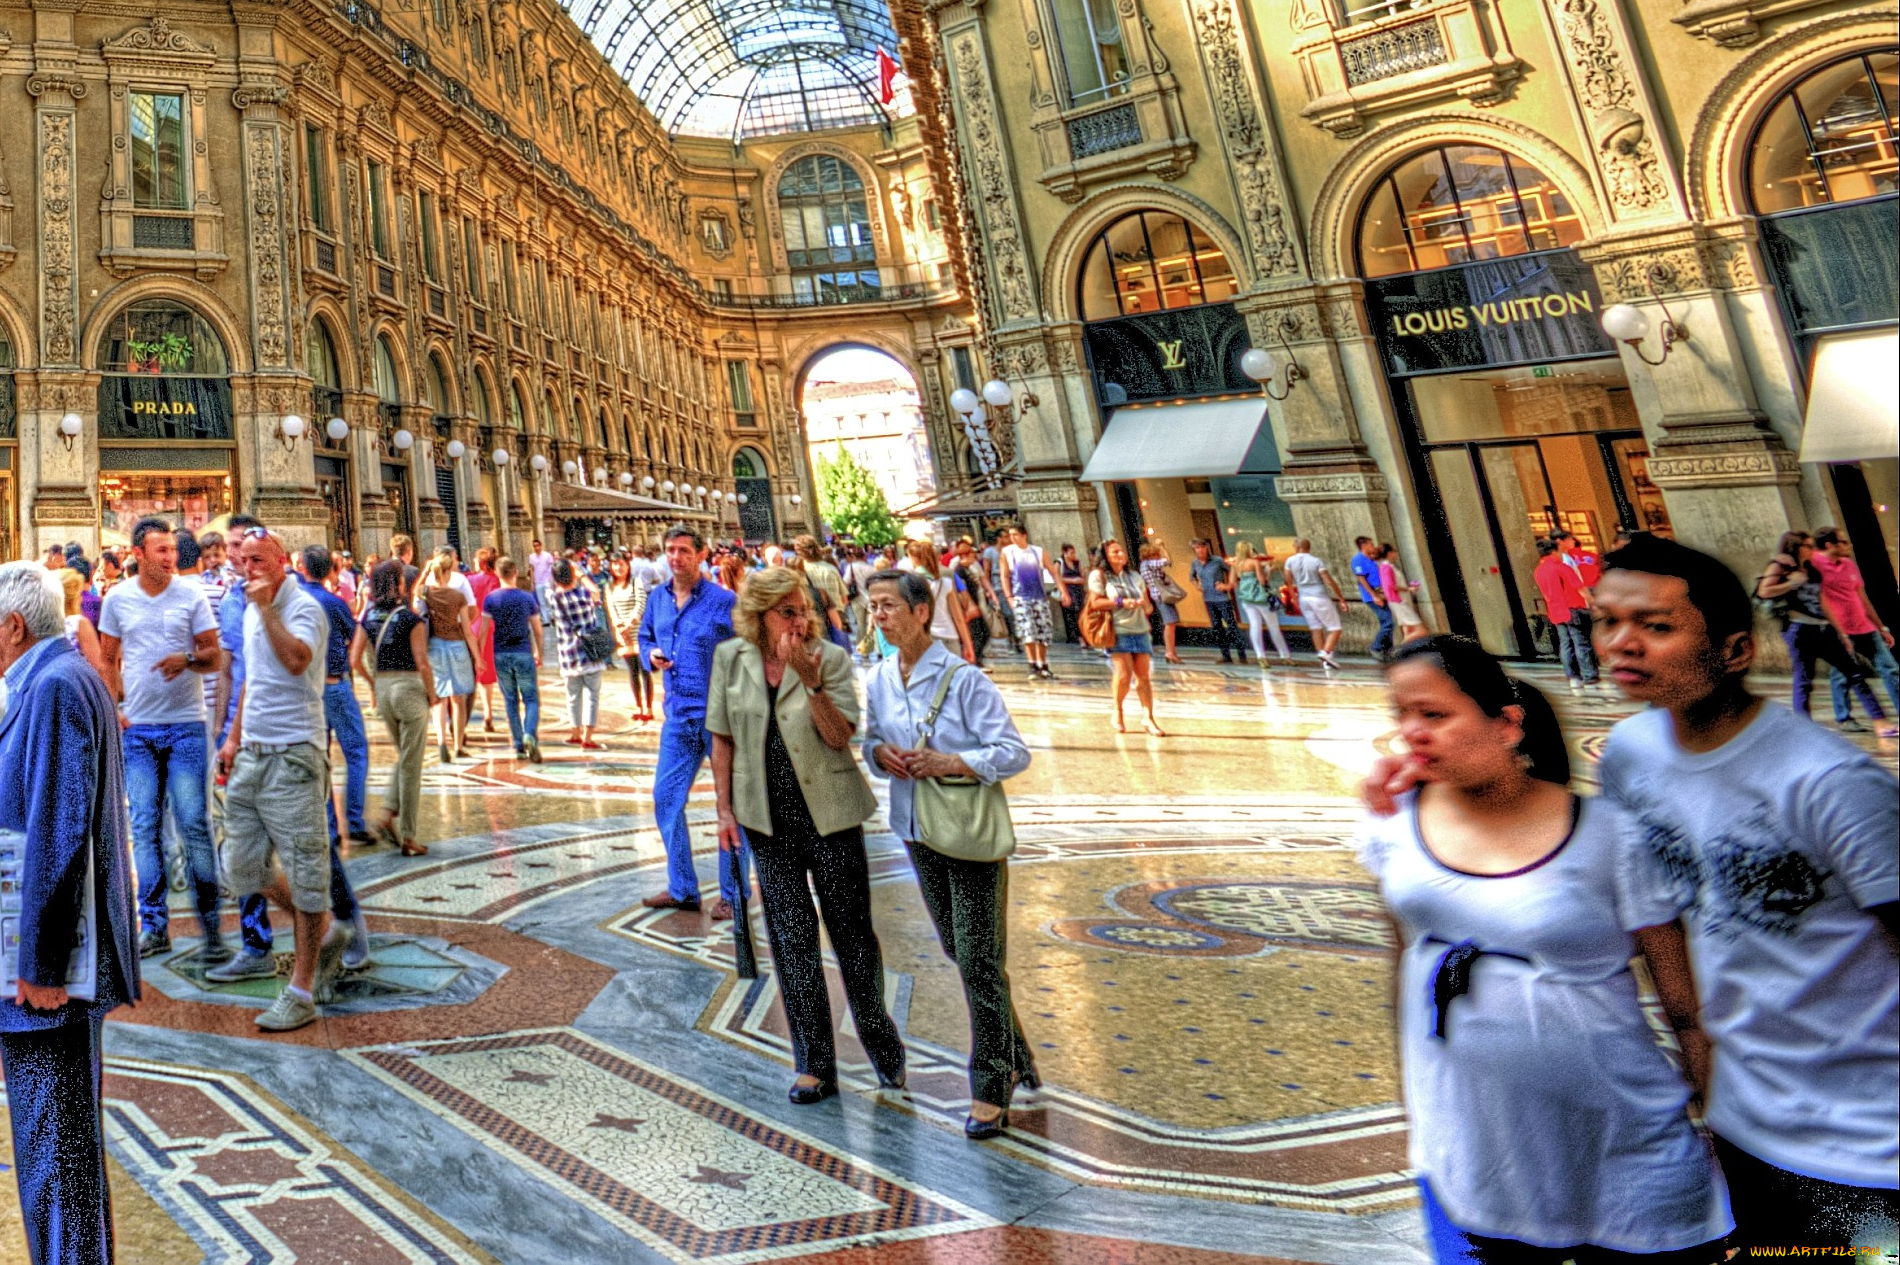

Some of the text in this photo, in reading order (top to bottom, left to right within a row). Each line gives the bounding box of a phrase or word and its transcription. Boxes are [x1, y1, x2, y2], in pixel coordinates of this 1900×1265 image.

[1393, 290, 1593, 336] LOUIS VUITTON
[133, 401, 197, 415] PRADA
